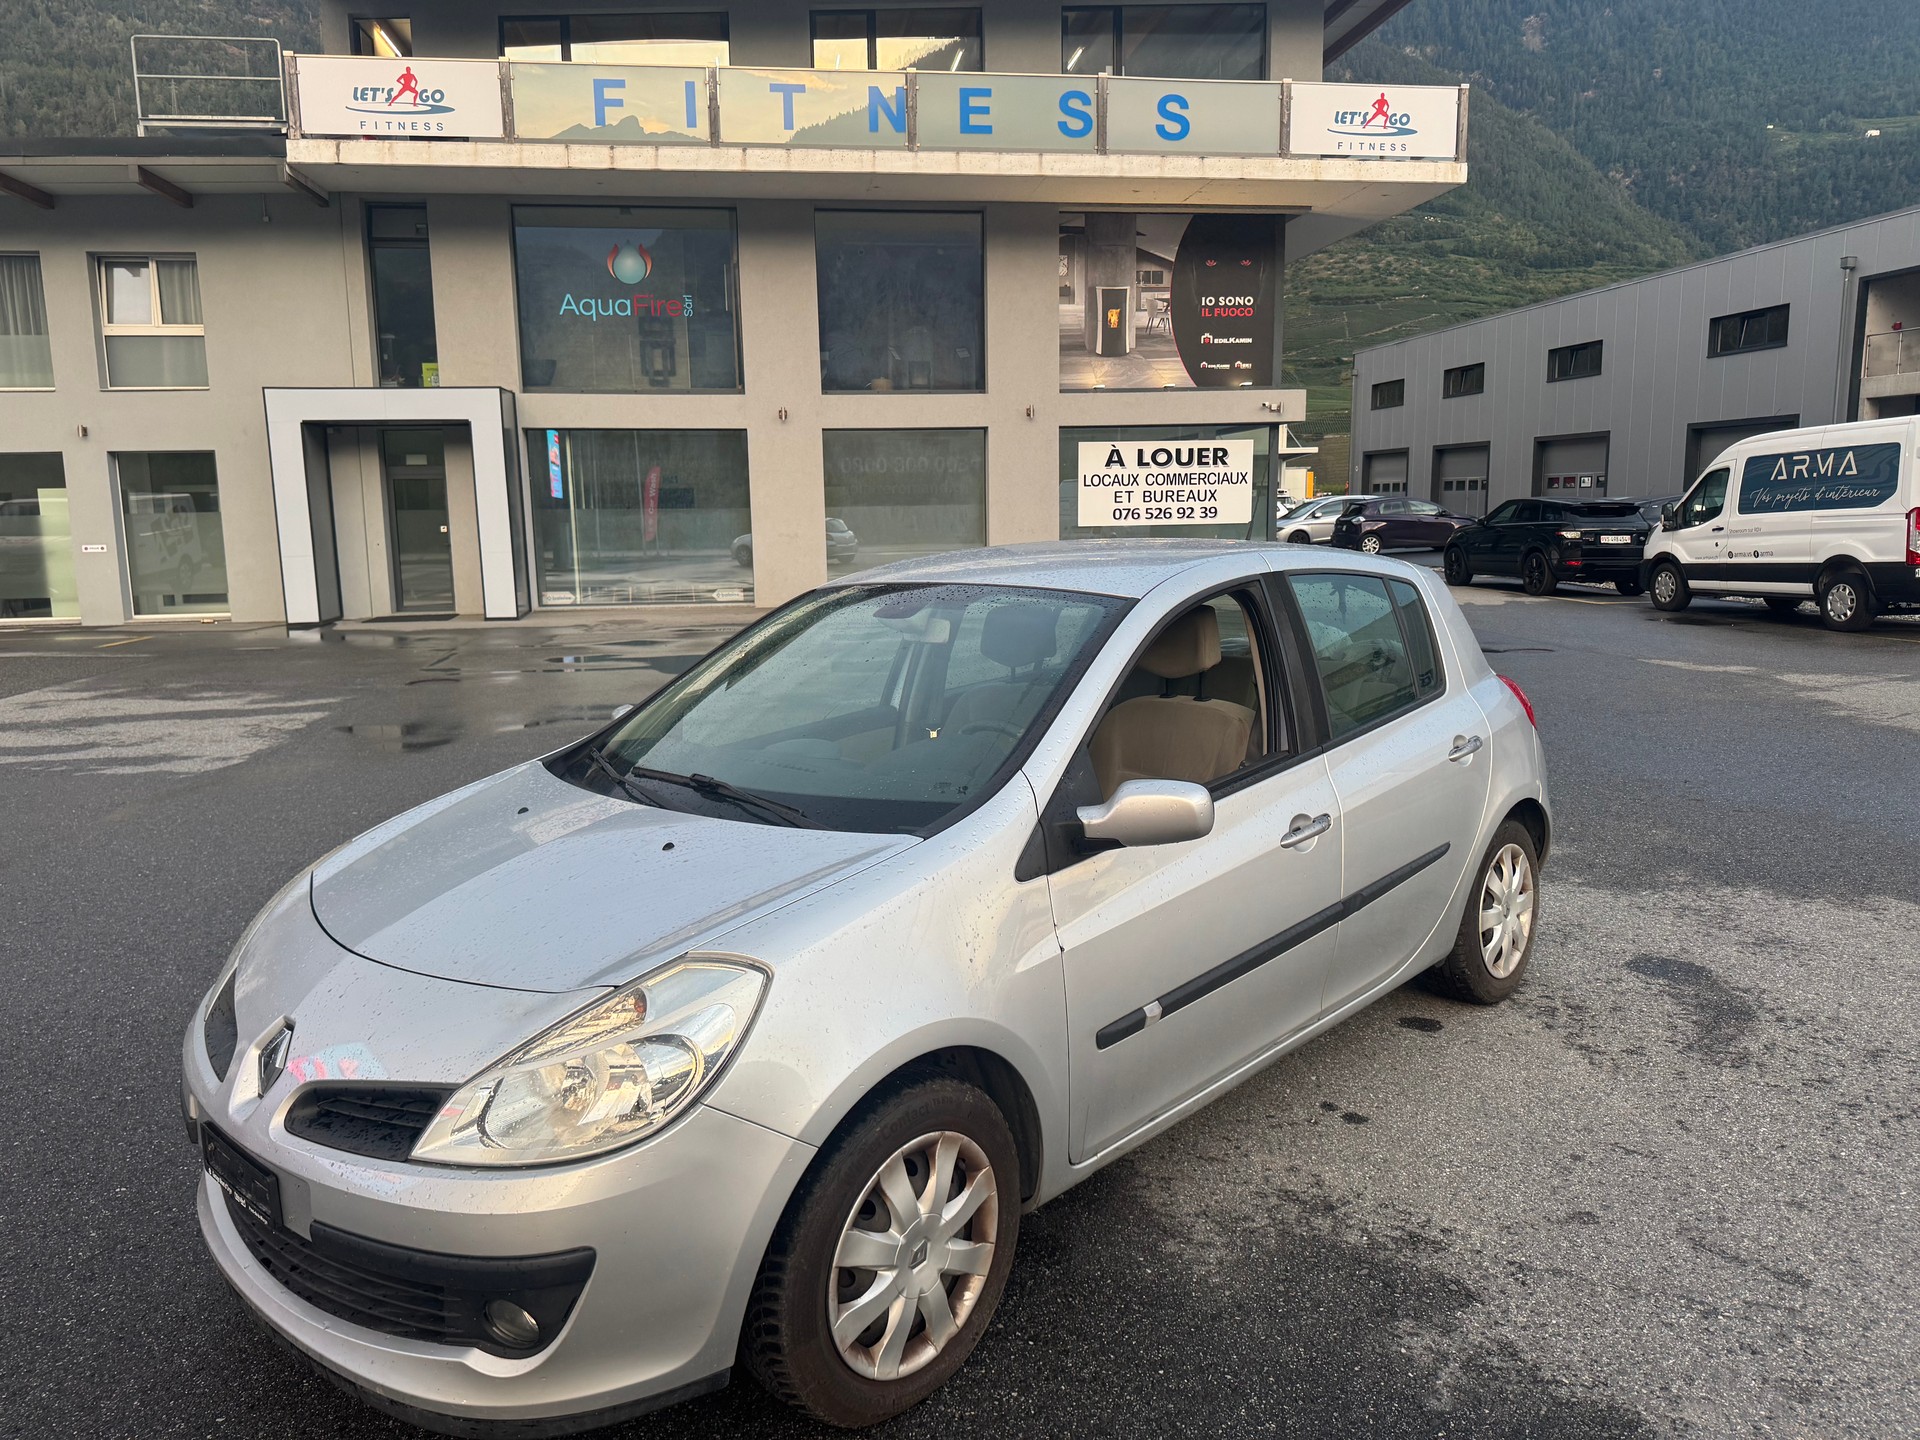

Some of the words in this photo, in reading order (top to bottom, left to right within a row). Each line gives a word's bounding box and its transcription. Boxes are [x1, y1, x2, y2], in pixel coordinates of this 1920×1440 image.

[352, 86, 394, 102] LET'S
[418, 88, 445, 103] GO
[360, 120, 445, 132] FITNESS
[1334, 111, 1369, 125] LET'S
[1388, 112, 1411, 126] GO
[1337, 141, 1407, 152] FITNESS
[559, 293, 683, 322] AquaFire
[1201, 296, 1216, 306] IO
[1218, 296, 1254, 306] SONO
[1201, 308, 1212, 317] IL
[1214, 308, 1254, 317] FUOCO
[1104, 444, 1126, 469] À
[1137, 447, 1230, 468] LOUER
[1083, 473, 1140, 487] LOCAUX
[1145, 471, 1248, 486] COMMERCIAUX
[1114, 490, 1135, 504] ET
[1142, 488, 1218, 503] BUREAUX
[1750, 487, 1773, 508] Vos
[1771, 487, 1813, 510] projets
[1112, 507, 1141, 521] 076
[1145, 506, 1172, 520] 526
[1176, 506, 1195, 520] 92
[1199, 505, 1218, 519] 39
